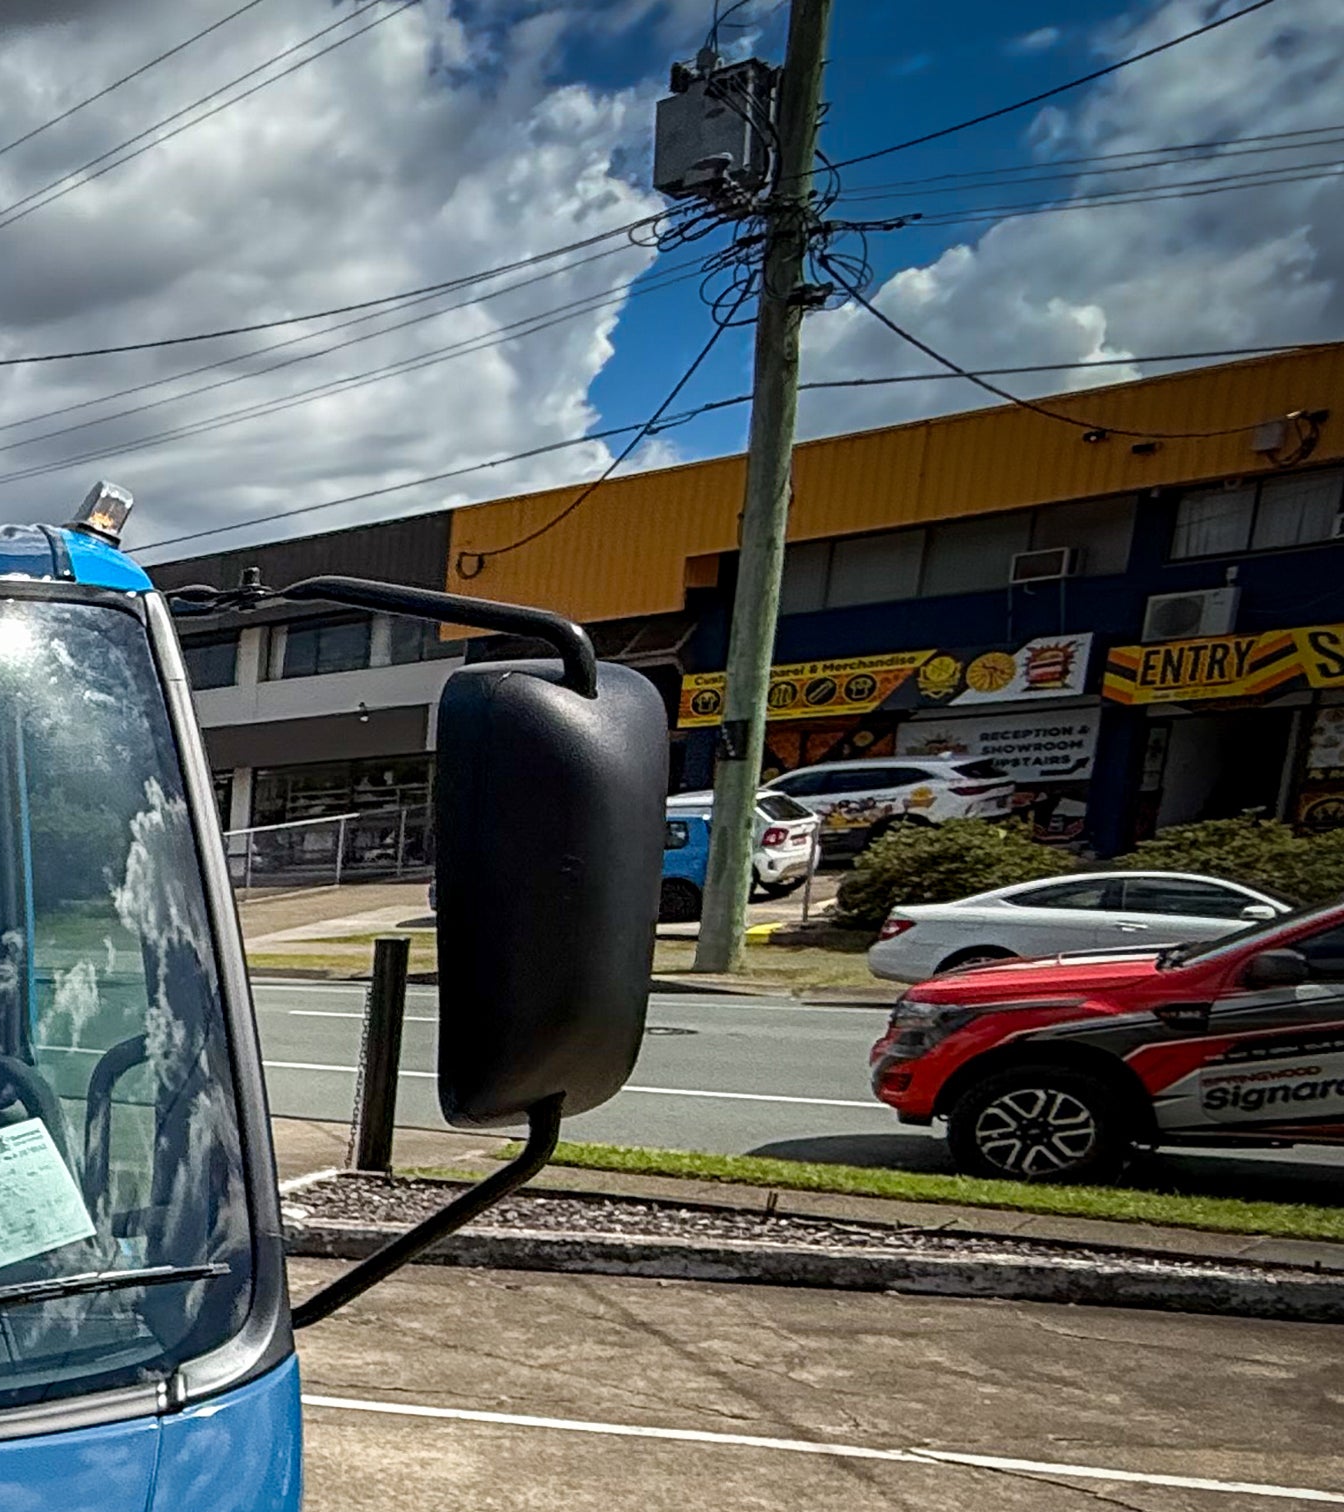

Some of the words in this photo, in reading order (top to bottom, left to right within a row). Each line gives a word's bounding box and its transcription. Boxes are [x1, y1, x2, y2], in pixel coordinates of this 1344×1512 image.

[822, 655, 916, 673] Merchandise
[1140, 640, 1256, 687] ENTRY
[979, 726, 1074, 741] RECEPTION
[981, 740, 1084, 755] SHOWROOM
